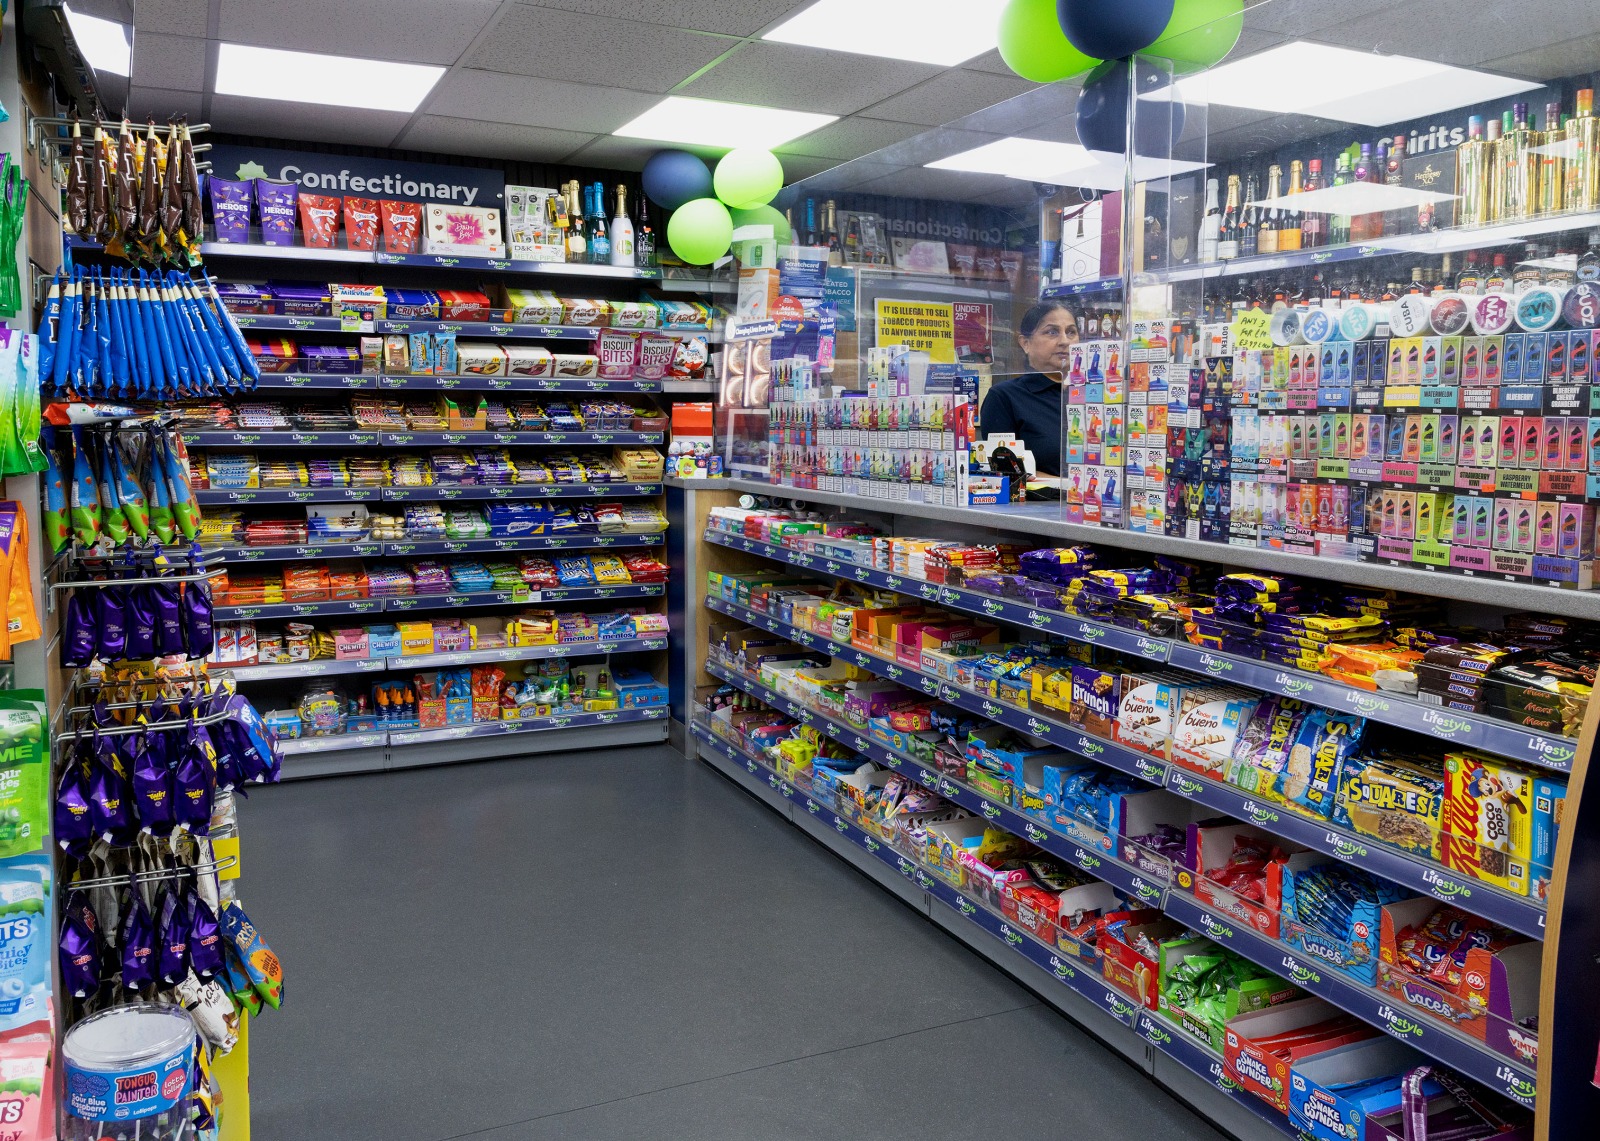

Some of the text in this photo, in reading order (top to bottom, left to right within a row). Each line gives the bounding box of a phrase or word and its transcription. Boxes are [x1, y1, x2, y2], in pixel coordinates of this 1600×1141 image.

[280, 166, 478, 206] Confectionary
[216, 202, 248, 212] HEROES
[264, 206, 294, 216] HEROES
[454, 222, 476, 236] Dairy
[459, 230, 473, 240] Box
[892, 306, 898, 314] IS
[900, 307, 924, 316] ILLEGAL
[935, 309, 948, 317] SELL
[955, 305, 980, 313] UNDER
[1484, 298, 1499, 330] ZYN
[1520, 301, 1553, 318] ZYN
[1577, 284, 1595, 327] zone
[883, 317, 949, 328] TOBACCO PRODUCTS
[1401, 301, 1414, 332] CUBA
[891, 329, 916, 337] ANYONE
[918, 330, 939, 338] UNDER
[1306, 314, 1328, 338] ZYN
[603, 341, 633, 350] BISCUIT
[644, 346, 672, 354] BISCUIT
[902, 340, 914, 348] AGE
[603, 350, 632, 362] BITES
[642, 354, 670, 365] BITES
[972, 496, 996, 504] HARIBO
[602, 631, 635, 639] mentos
[1079, 623, 1105, 637] Lifestyle
[371, 640, 399, 649] CHEWITS
[1137, 638, 1166, 653] Lifestyle
[1200, 654, 1233, 671] Lifestyle
[1460, 660, 1488, 671] SNICKERS
[1275, 673, 1313, 691] Lifestyle
[1450, 672, 1476, 683] SNICKERS
[1073, 685, 1109, 713] Brunch
[1124, 701, 1154, 714] bueno
[1346, 692, 1389, 711] Lifestyle
[1184, 714, 1218, 728] bueno
[1422, 711, 1472, 733] Lifestyle
[1078, 738, 1104, 754] Lifestyle
[1135, 759, 1164, 777] Lifestyle
[1171, 774, 1204, 793] Lifestyle
[1243, 802, 1279, 822] Lifestyle
[1495, 807, 1507, 836] pops
[1325, 833, 1367, 857] Lifestyle
[1076, 849, 1101, 868] Lifestyle
[1422, 871, 1472, 898] Lifestyle
[1200, 914, 1233, 938] Lifestyle
[1301, 935, 1343, 964] Laces
[1050, 957, 1074, 978] Lifestyle
[1282, 956, 1321, 983] Lifestyle
[1105, 993, 1133, 1016] Lifestyle
[1402, 984, 1452, 1015] Laces
[1378, 1006, 1424, 1037] Lifestyle
[1141, 1018, 1172, 1044] Lifestyle
[1240, 1051, 1267, 1075] SNAKE
[116, 1072, 155, 1090] TONGUE
[1236, 1058, 1273, 1089] WINDER
[72, 1093, 106, 1106] Sour Blue
[116, 1085, 158, 1103] PAINTER
[71, 1100, 107, 1114] Raspberry
[1309, 1096, 1340, 1120] SNAKE
[1304, 1104, 1346, 1134] WINDER
